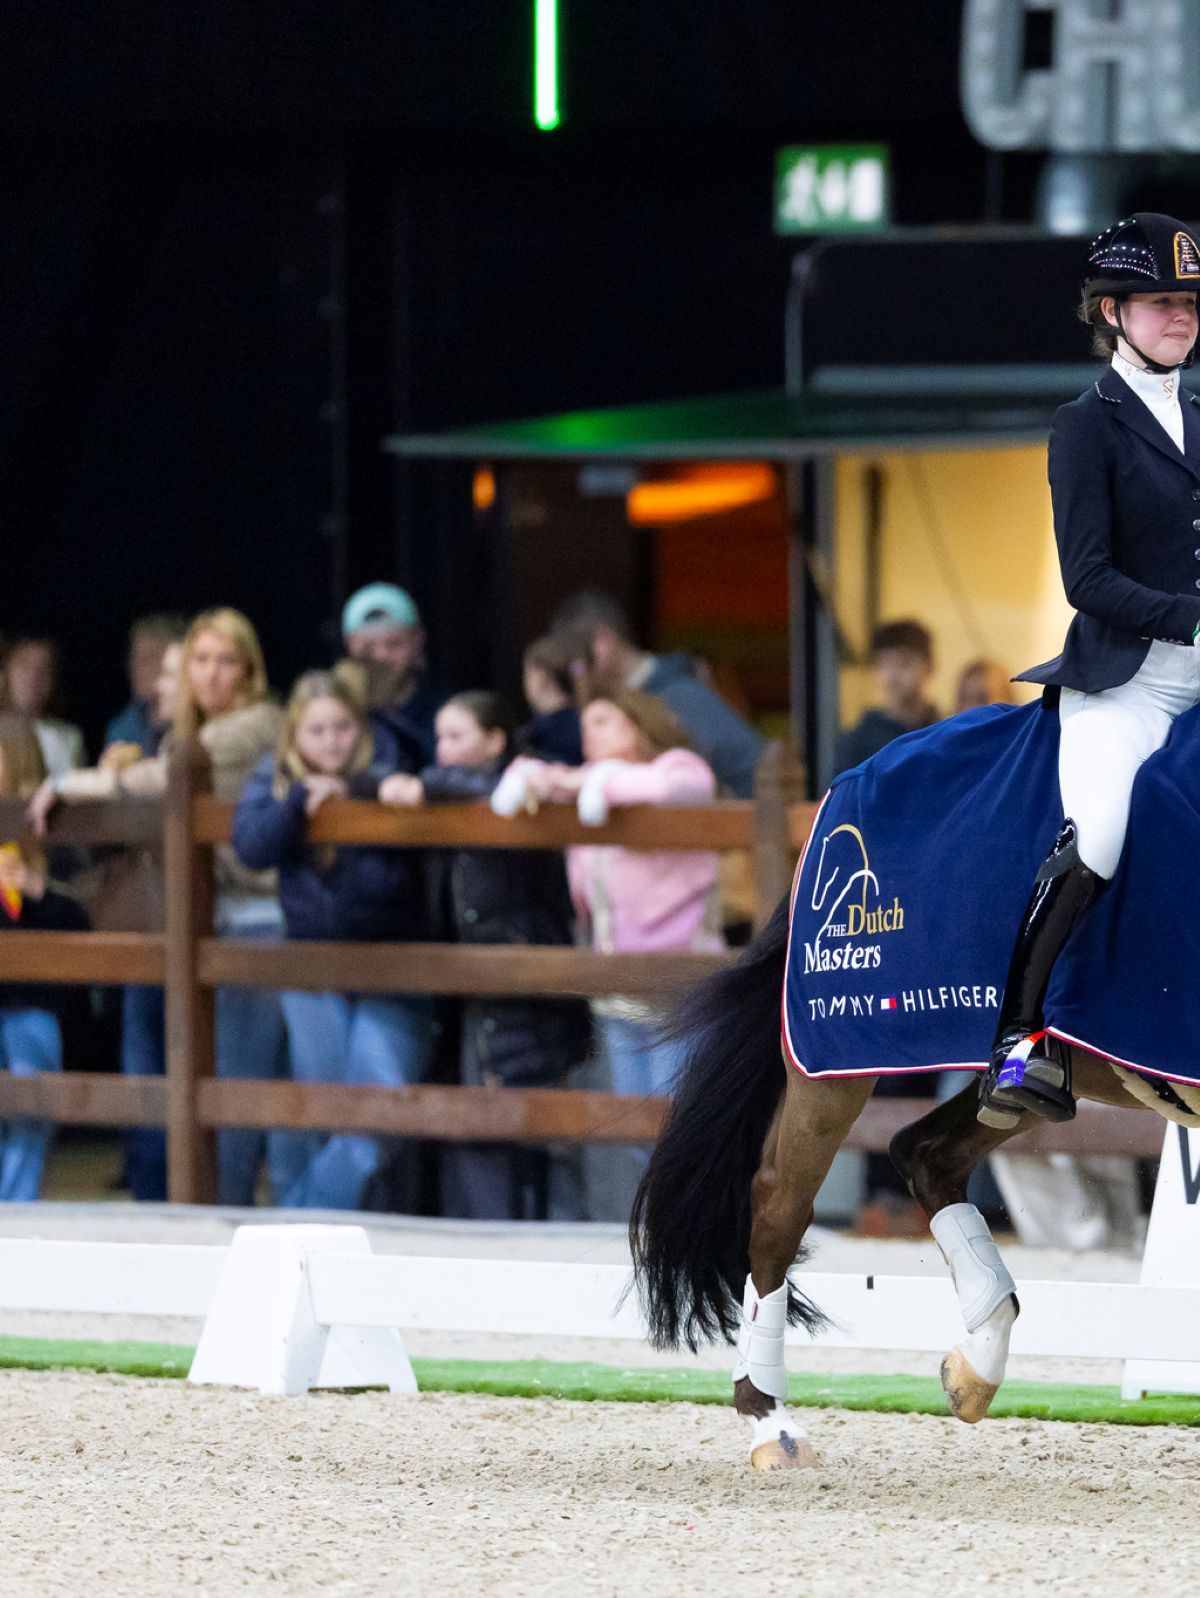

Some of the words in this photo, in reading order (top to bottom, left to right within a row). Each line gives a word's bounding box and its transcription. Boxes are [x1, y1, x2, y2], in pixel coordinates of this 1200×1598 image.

[826, 923, 848, 938] THE
[847, 897, 904, 936] Dutch
[803, 940, 882, 974] Masters
[808, 994, 875, 1021] TOMMY
[902, 985, 998, 1013] HILFIGER
